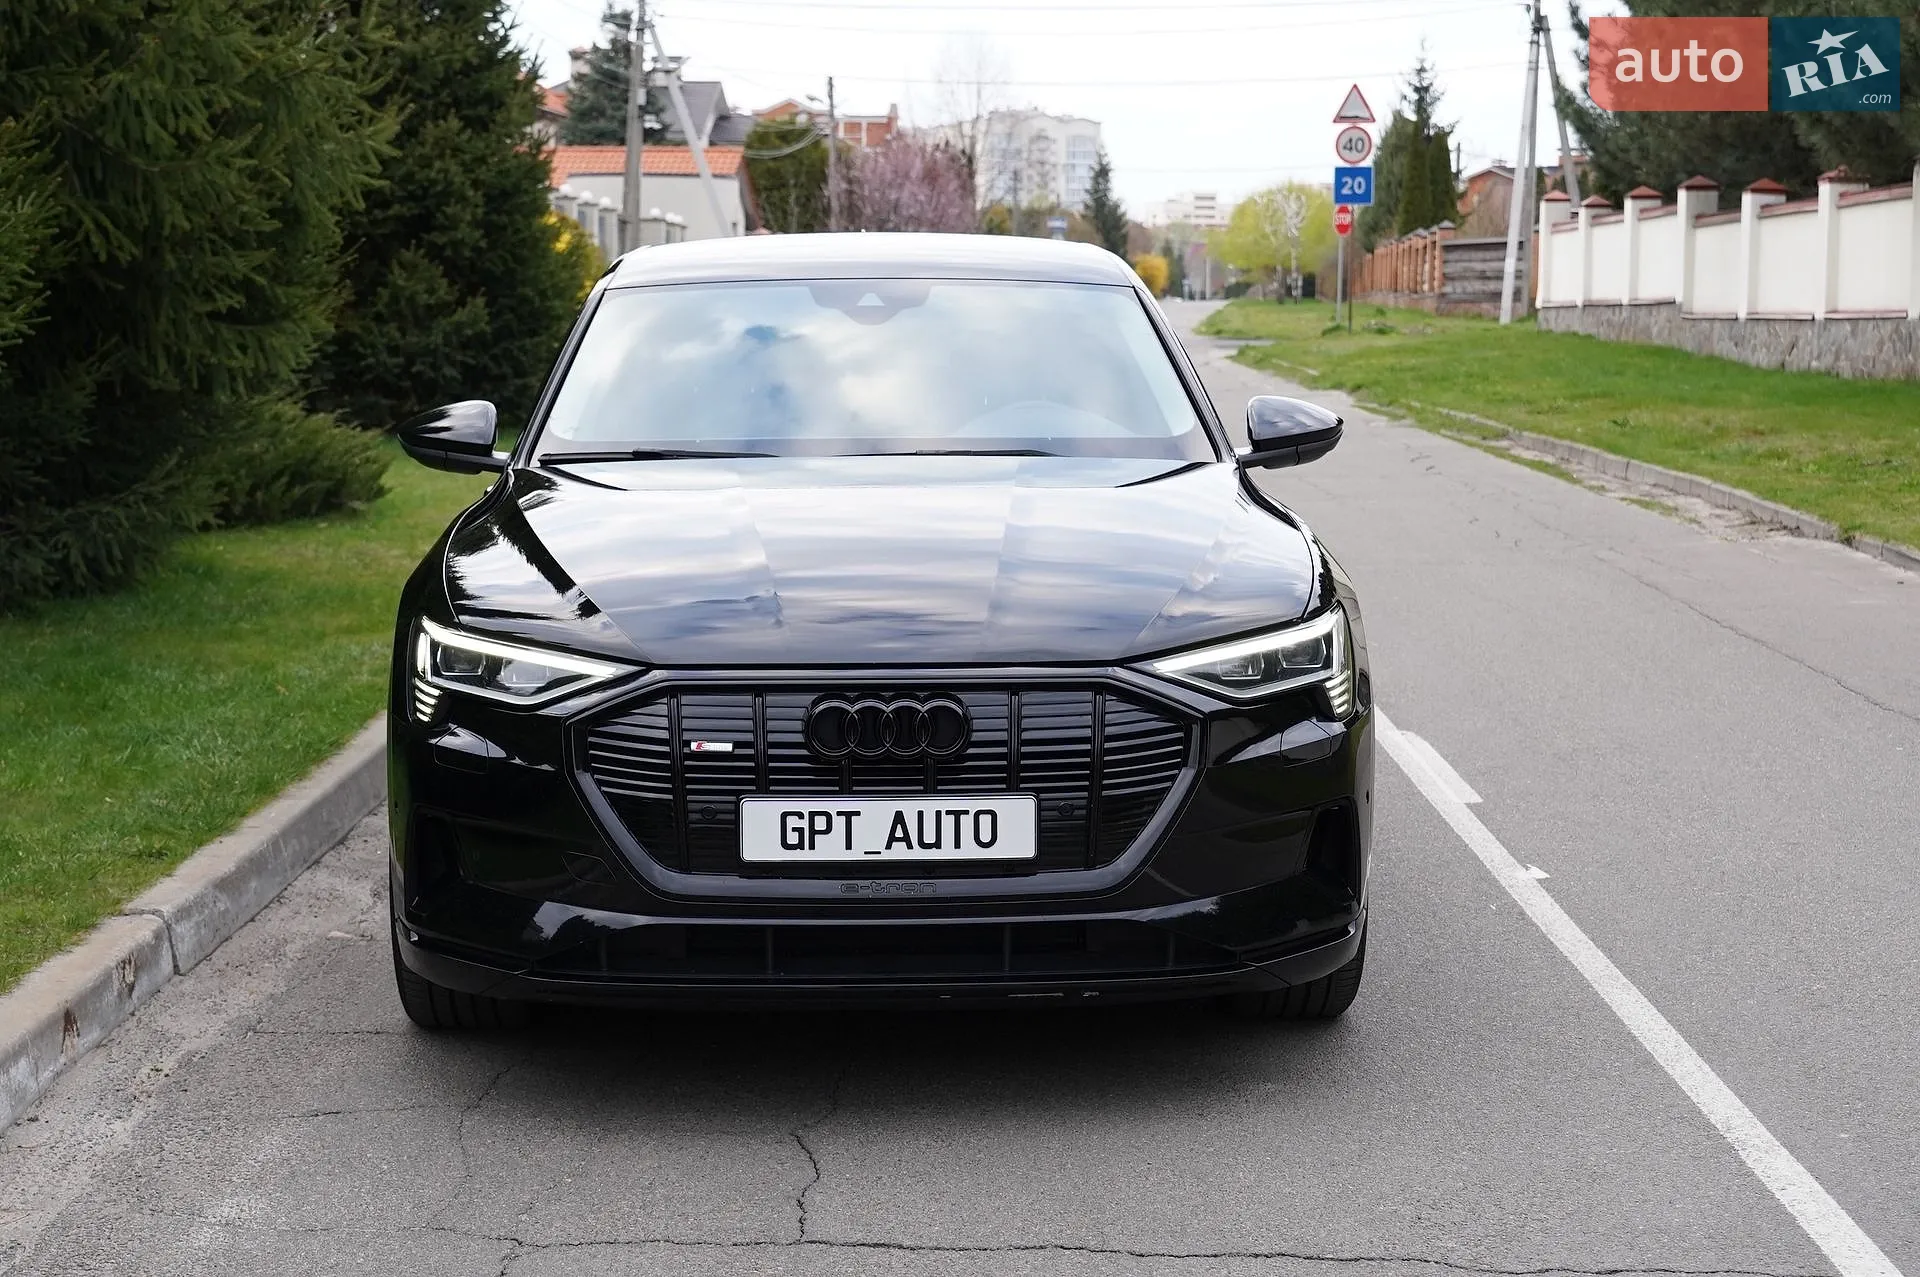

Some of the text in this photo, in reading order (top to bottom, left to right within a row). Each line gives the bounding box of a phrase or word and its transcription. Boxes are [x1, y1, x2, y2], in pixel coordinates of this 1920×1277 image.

[1343, 137, 1365, 153] 40
[1341, 176, 1366, 195] 20
[1335, 213, 1351, 225] STOP
[780, 809, 998, 855] GPT_AUTO
[840, 881, 937, 894] e-tron
